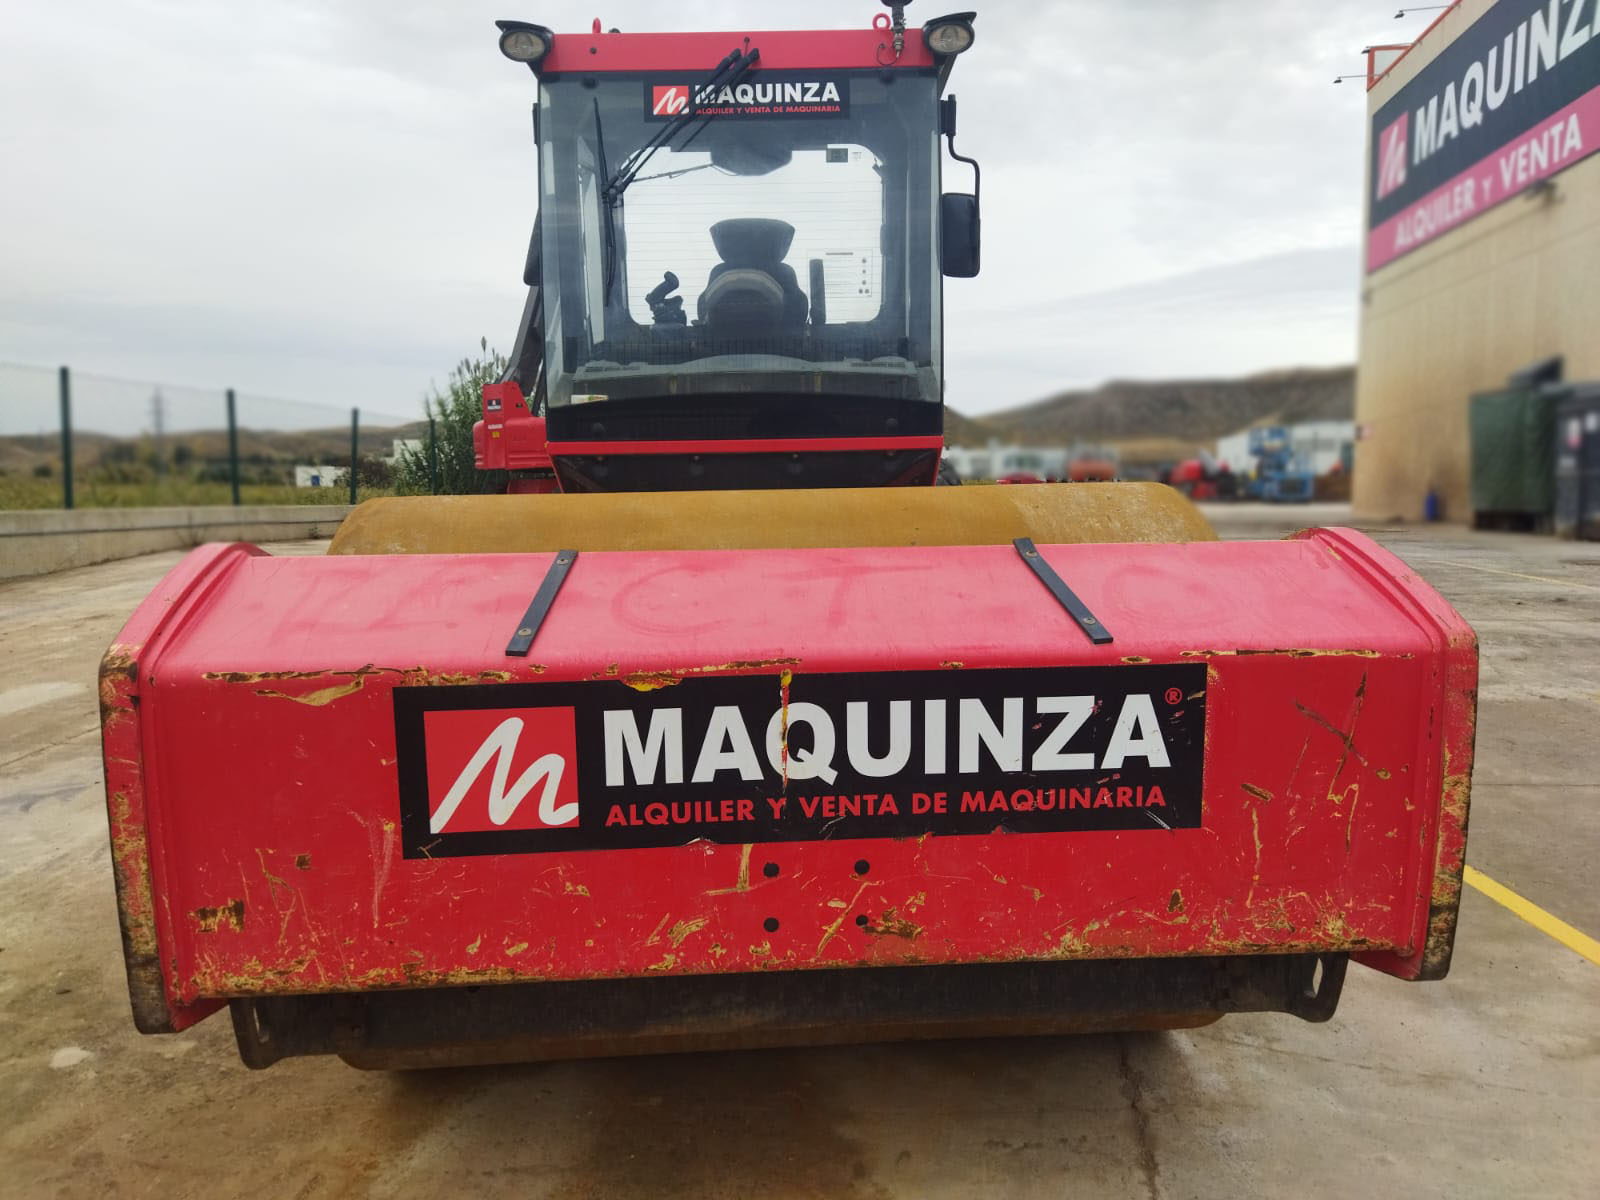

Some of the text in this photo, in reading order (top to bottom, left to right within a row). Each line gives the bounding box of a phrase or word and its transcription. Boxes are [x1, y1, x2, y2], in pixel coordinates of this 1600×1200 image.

[695, 82, 840, 105] MAQUINZA
[744, 106, 771, 114] VENTA
[785, 105, 840, 113] MAQUINARIA
[1395, 177, 1475, 251] ALQUILER
[1500, 112, 1582, 191] VENTA
[603, 693, 1171, 787] MAQUINZA
[604, 785, 1166, 827] ALQUILER Y VENTA DE MAQUINARIA
